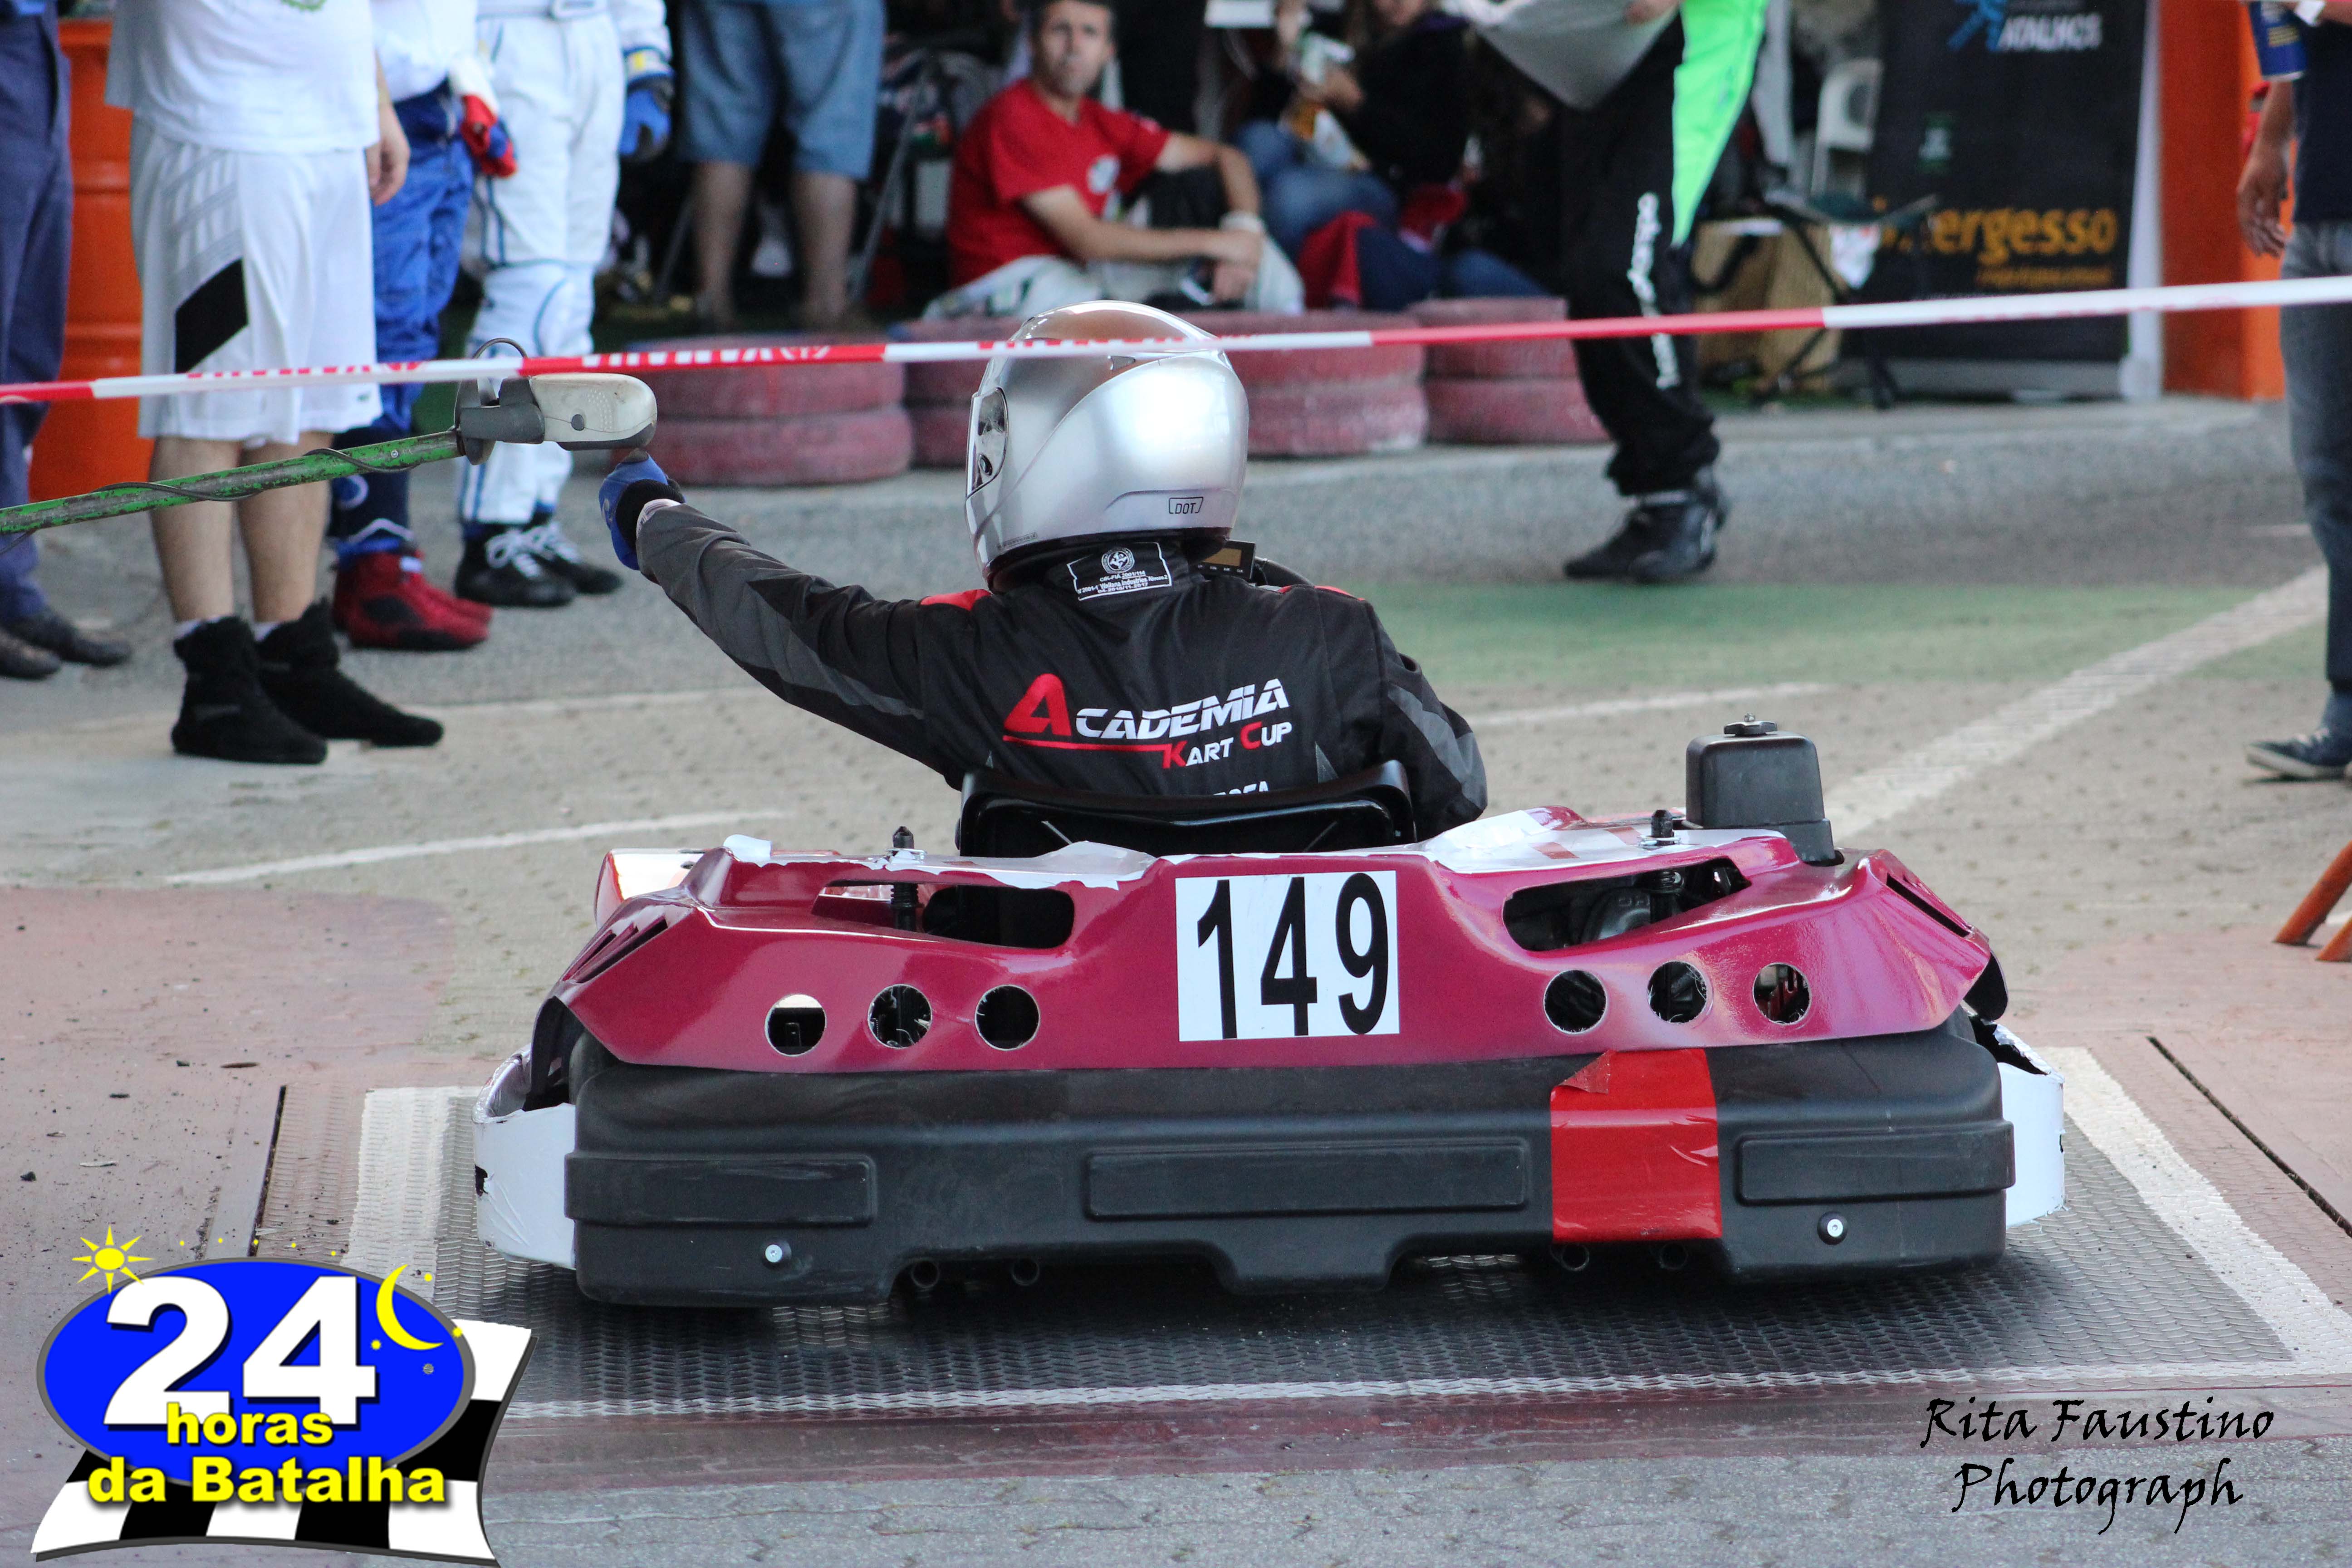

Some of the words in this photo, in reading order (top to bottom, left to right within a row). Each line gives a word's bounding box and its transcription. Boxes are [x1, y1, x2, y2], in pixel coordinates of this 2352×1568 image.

[1175, 503, 1196, 514] DOT
[1003, 673, 1290, 740] ACADEMIA
[1161, 737, 1234, 769] KART
[1240, 721, 1292, 750] CUP
[1197, 872, 1388, 1039] 149
